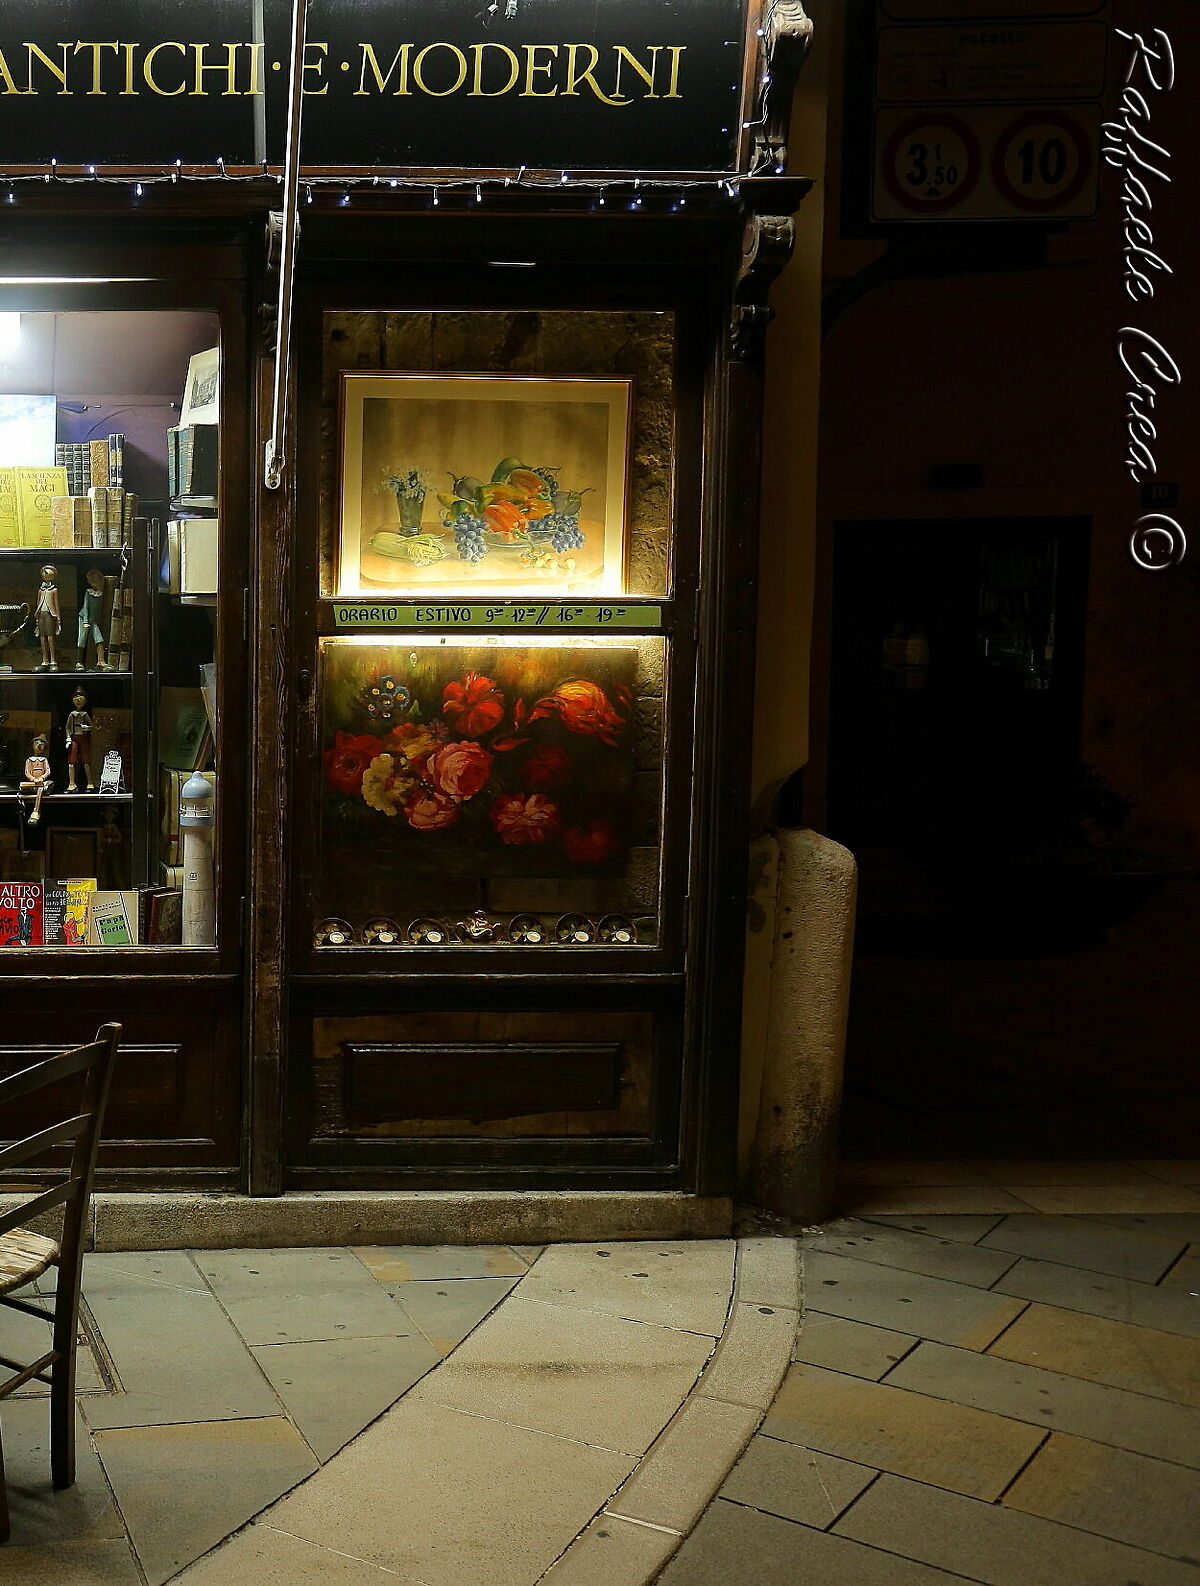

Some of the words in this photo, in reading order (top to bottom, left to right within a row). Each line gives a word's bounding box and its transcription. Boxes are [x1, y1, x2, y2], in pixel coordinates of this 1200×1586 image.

[301, 43, 330, 95] E
[353, 42, 688, 106] MODERNI
[1017, 138, 1067, 185] 10
[339, 607, 398, 622] ORARIO
[416, 607, 471, 622] ESTIVO
